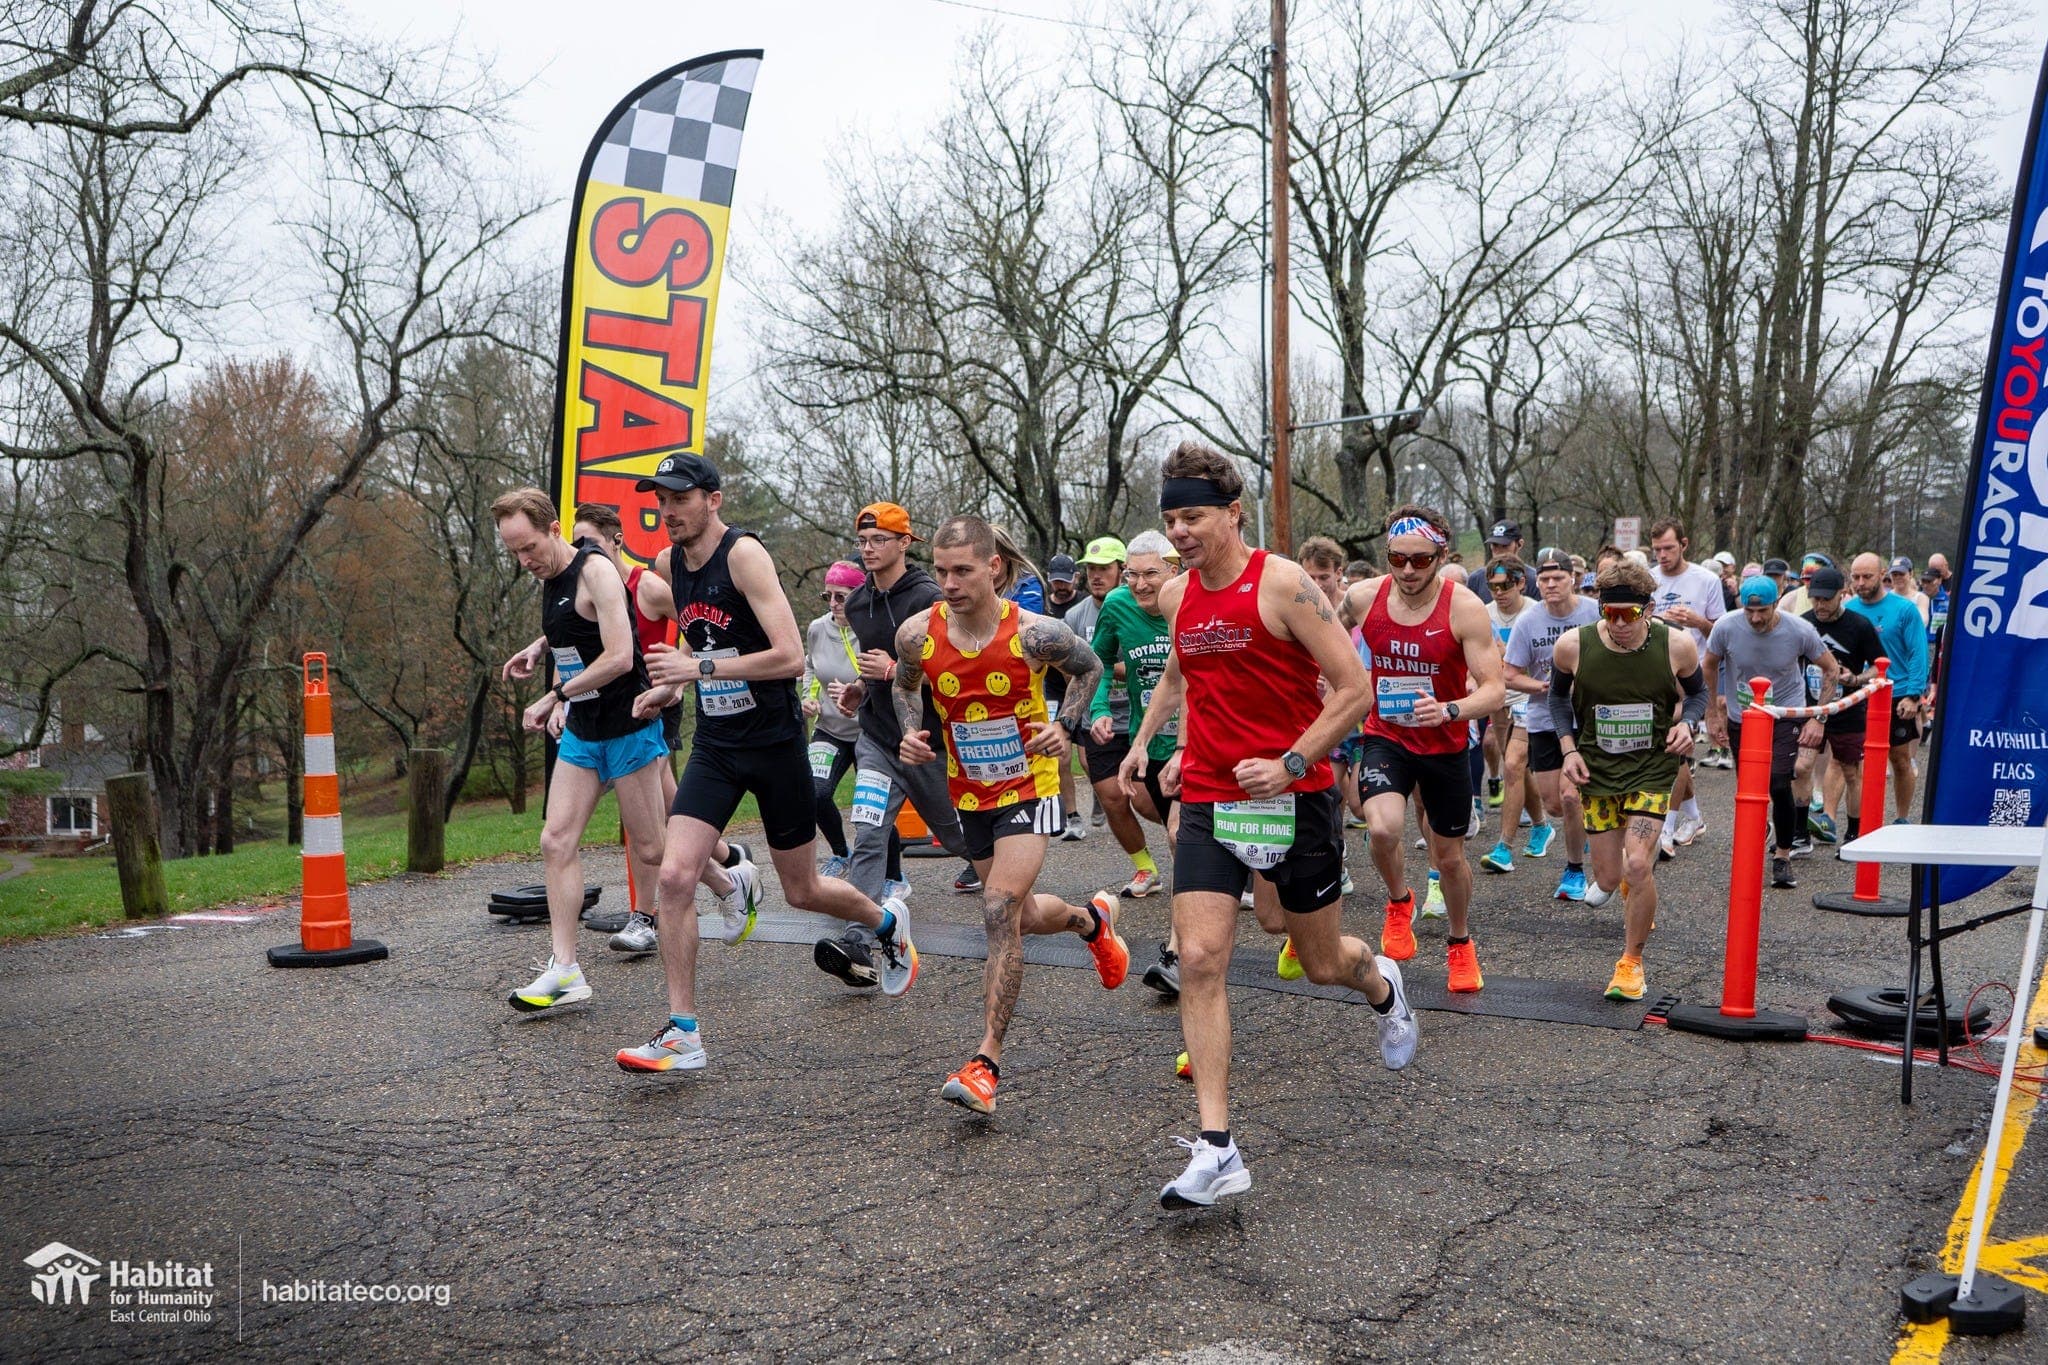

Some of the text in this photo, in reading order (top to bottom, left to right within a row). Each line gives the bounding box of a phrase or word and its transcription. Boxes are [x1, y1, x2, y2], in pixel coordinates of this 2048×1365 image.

[574, 197, 714, 573] STAR
[1546, 626, 1560, 636] IN
[1128, 643, 1171, 660] ROTARY
[1390, 640, 1419, 657] RIO
[1374, 655, 1440, 675] GRANDE
[731, 697, 750, 709] 2079
[1380, 699, 1410, 708] RUN FOR
[1597, 722, 1650, 735] MILBURN
[1968, 729, 2048, 750] RAVENHILL
[958, 739, 1021, 760] FREEMAN
[1005, 762, 1024, 776] 2027
[1360, 766, 1392, 787] USA
[1992, 761, 2035, 780] FLAGS
[866, 791, 886, 804] HOME
[865, 810, 880, 822] 2108
[1216, 819, 1292, 836] RUN FOR HOME
